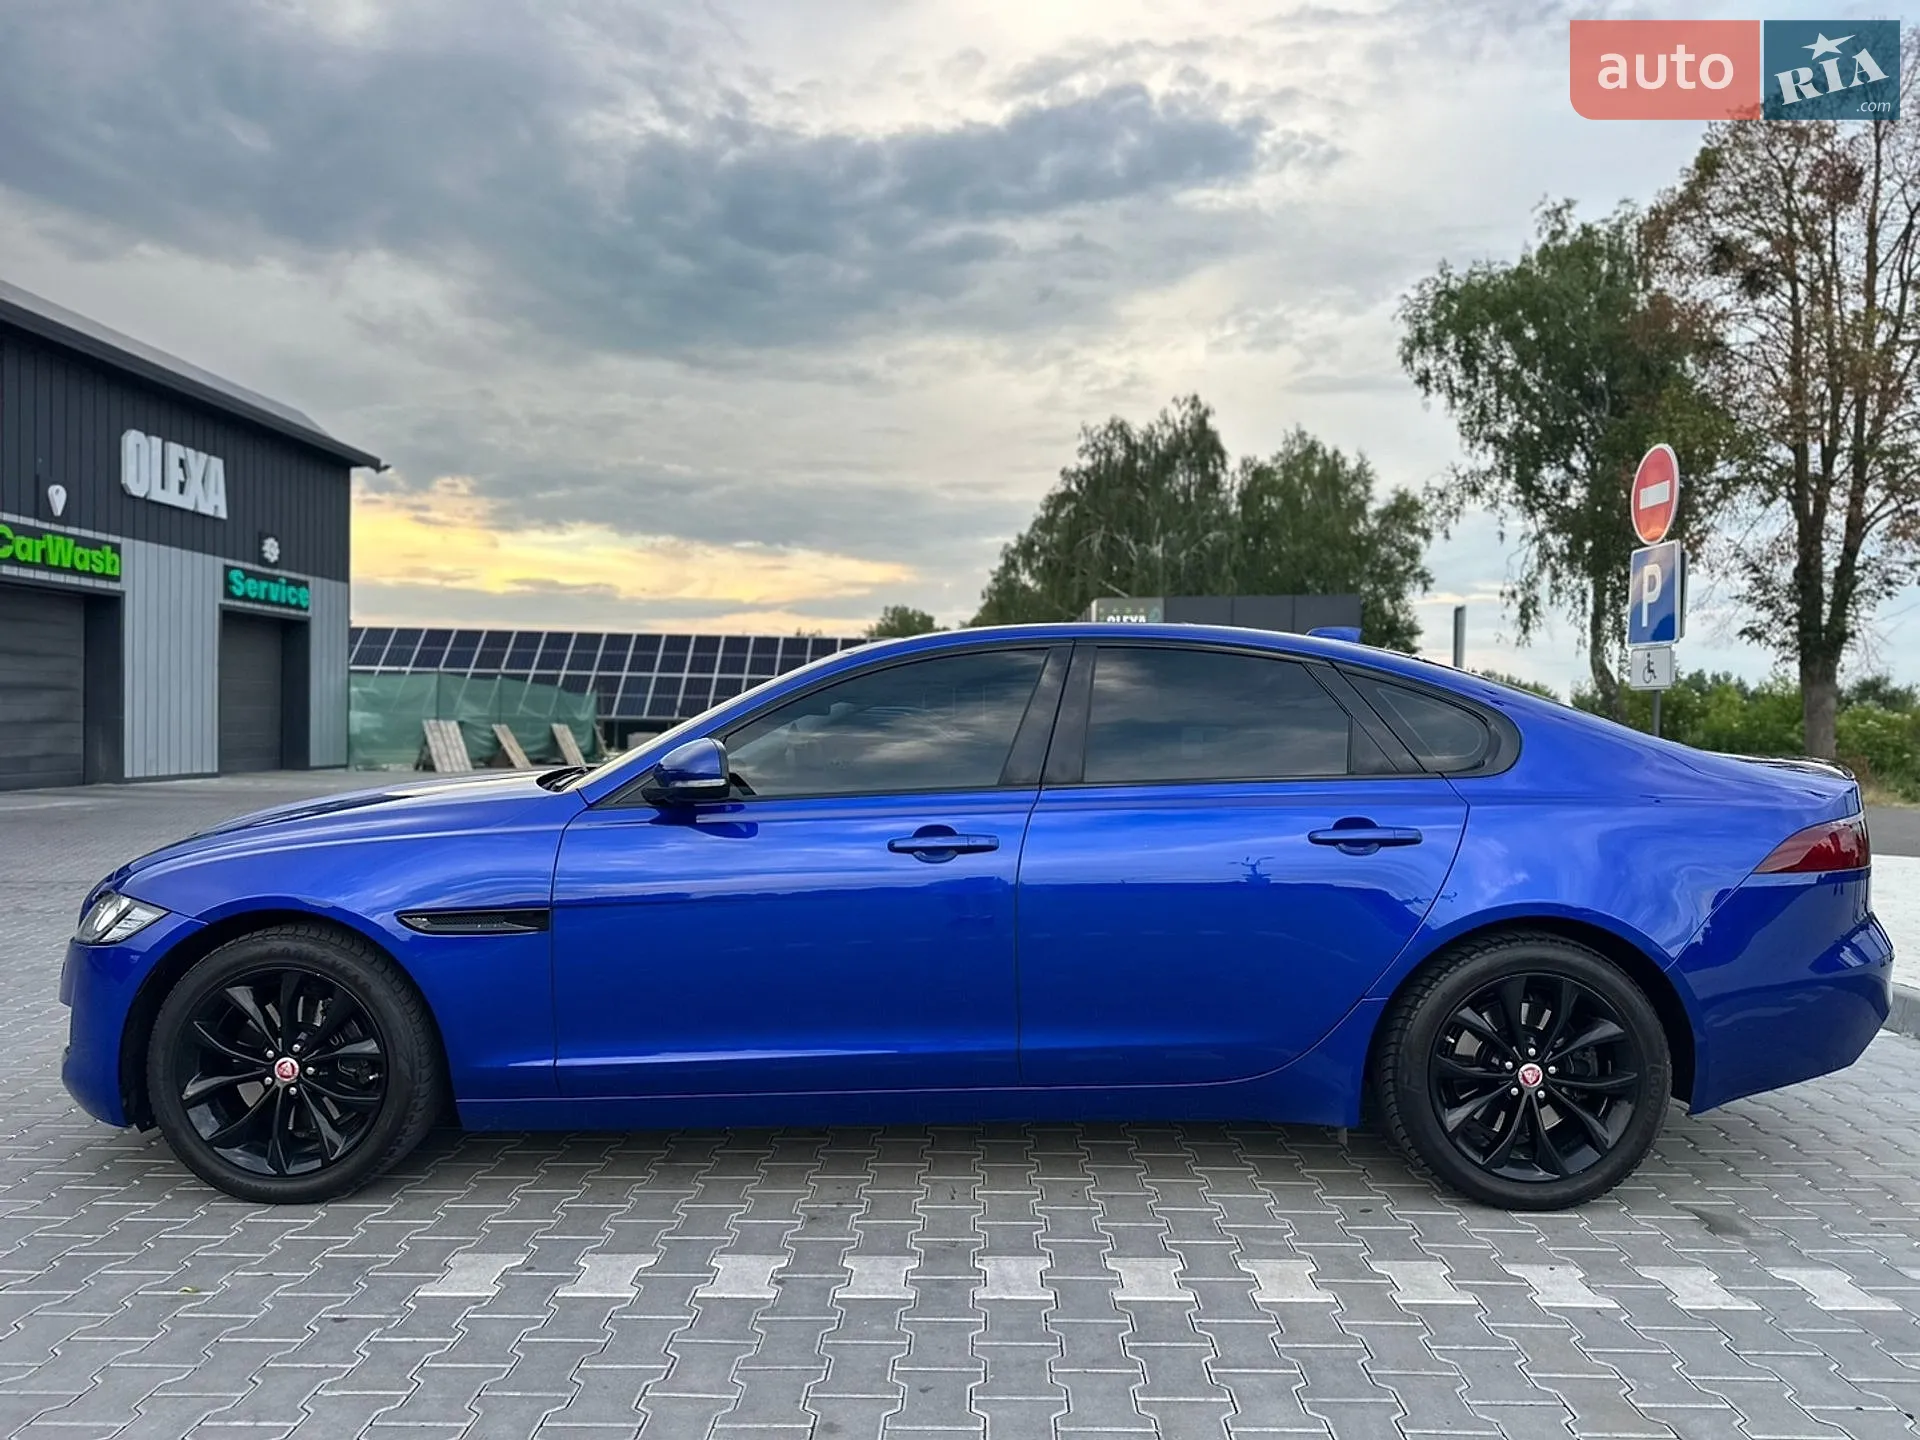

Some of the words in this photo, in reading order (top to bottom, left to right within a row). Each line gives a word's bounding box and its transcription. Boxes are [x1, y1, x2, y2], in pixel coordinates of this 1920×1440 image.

[121, 429, 228, 520] OLEXA
[228, 569, 310, 608] Service
[1642, 563, 1662, 628] P
